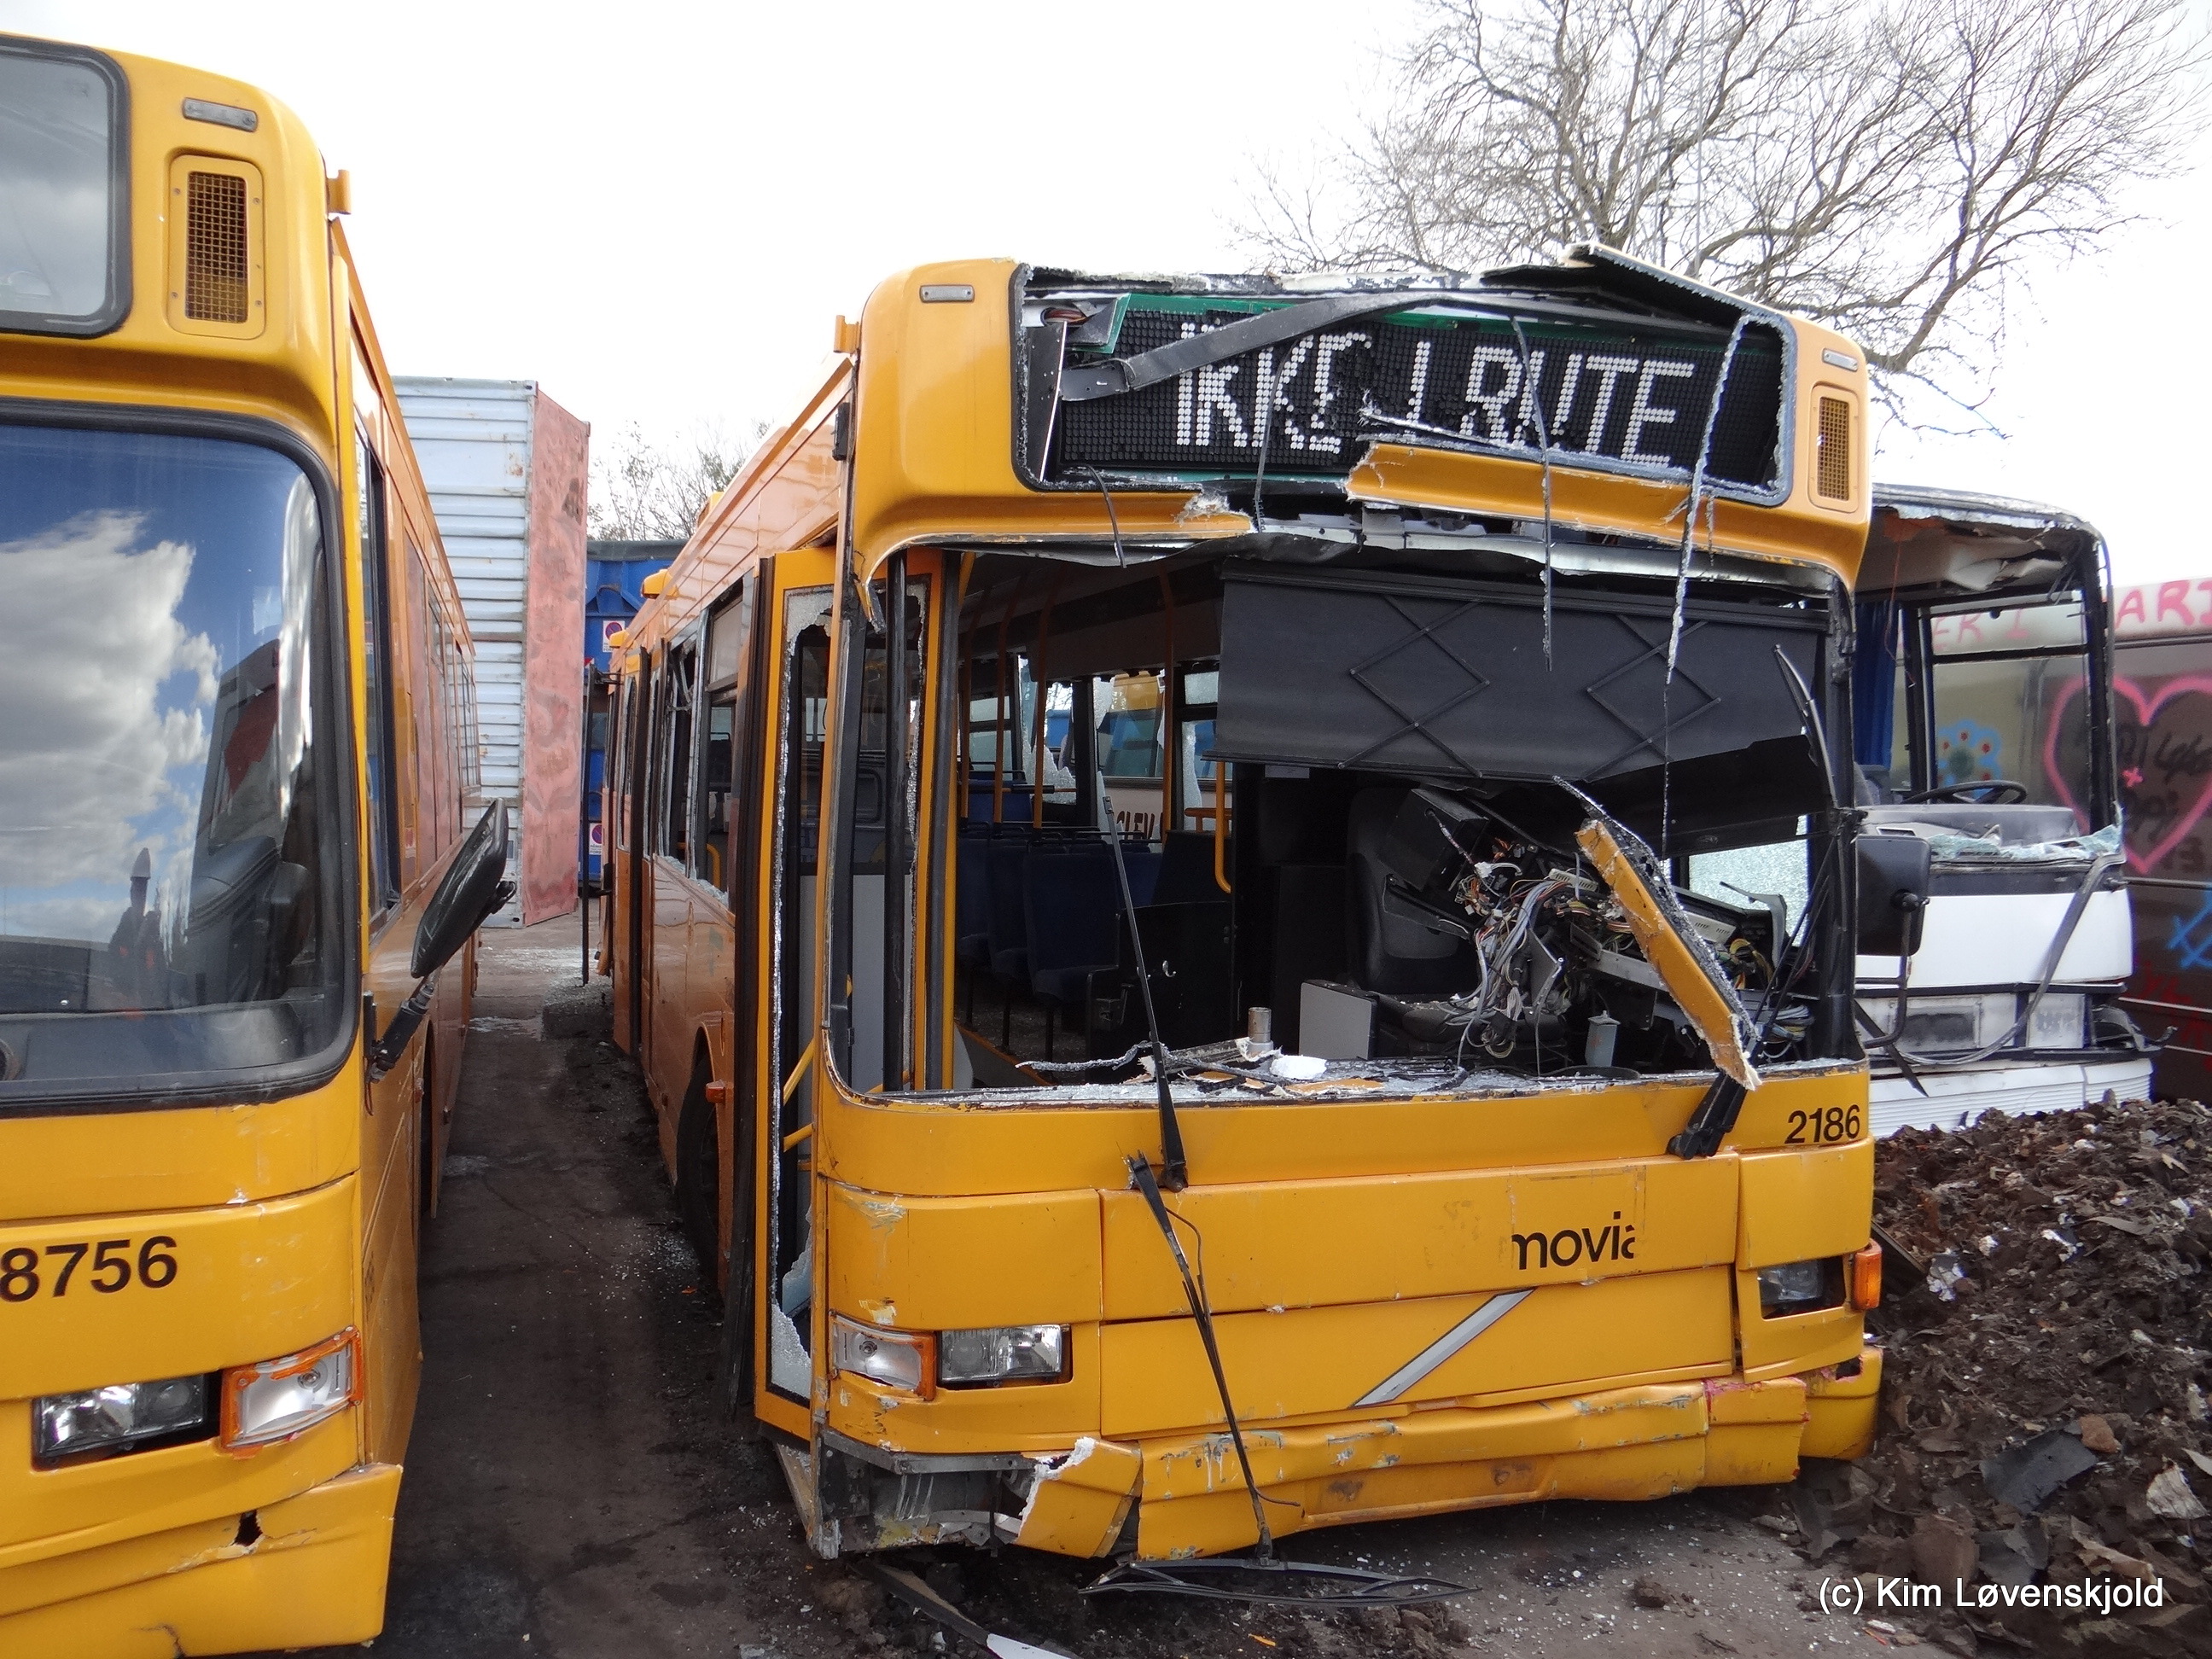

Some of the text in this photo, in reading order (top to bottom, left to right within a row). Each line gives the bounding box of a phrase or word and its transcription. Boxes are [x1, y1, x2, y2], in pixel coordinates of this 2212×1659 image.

[1458, 345, 1696, 469] RUTE
[1784, 1103, 1860, 1144] 2186
[0, 1235, 178, 1303] 8756
